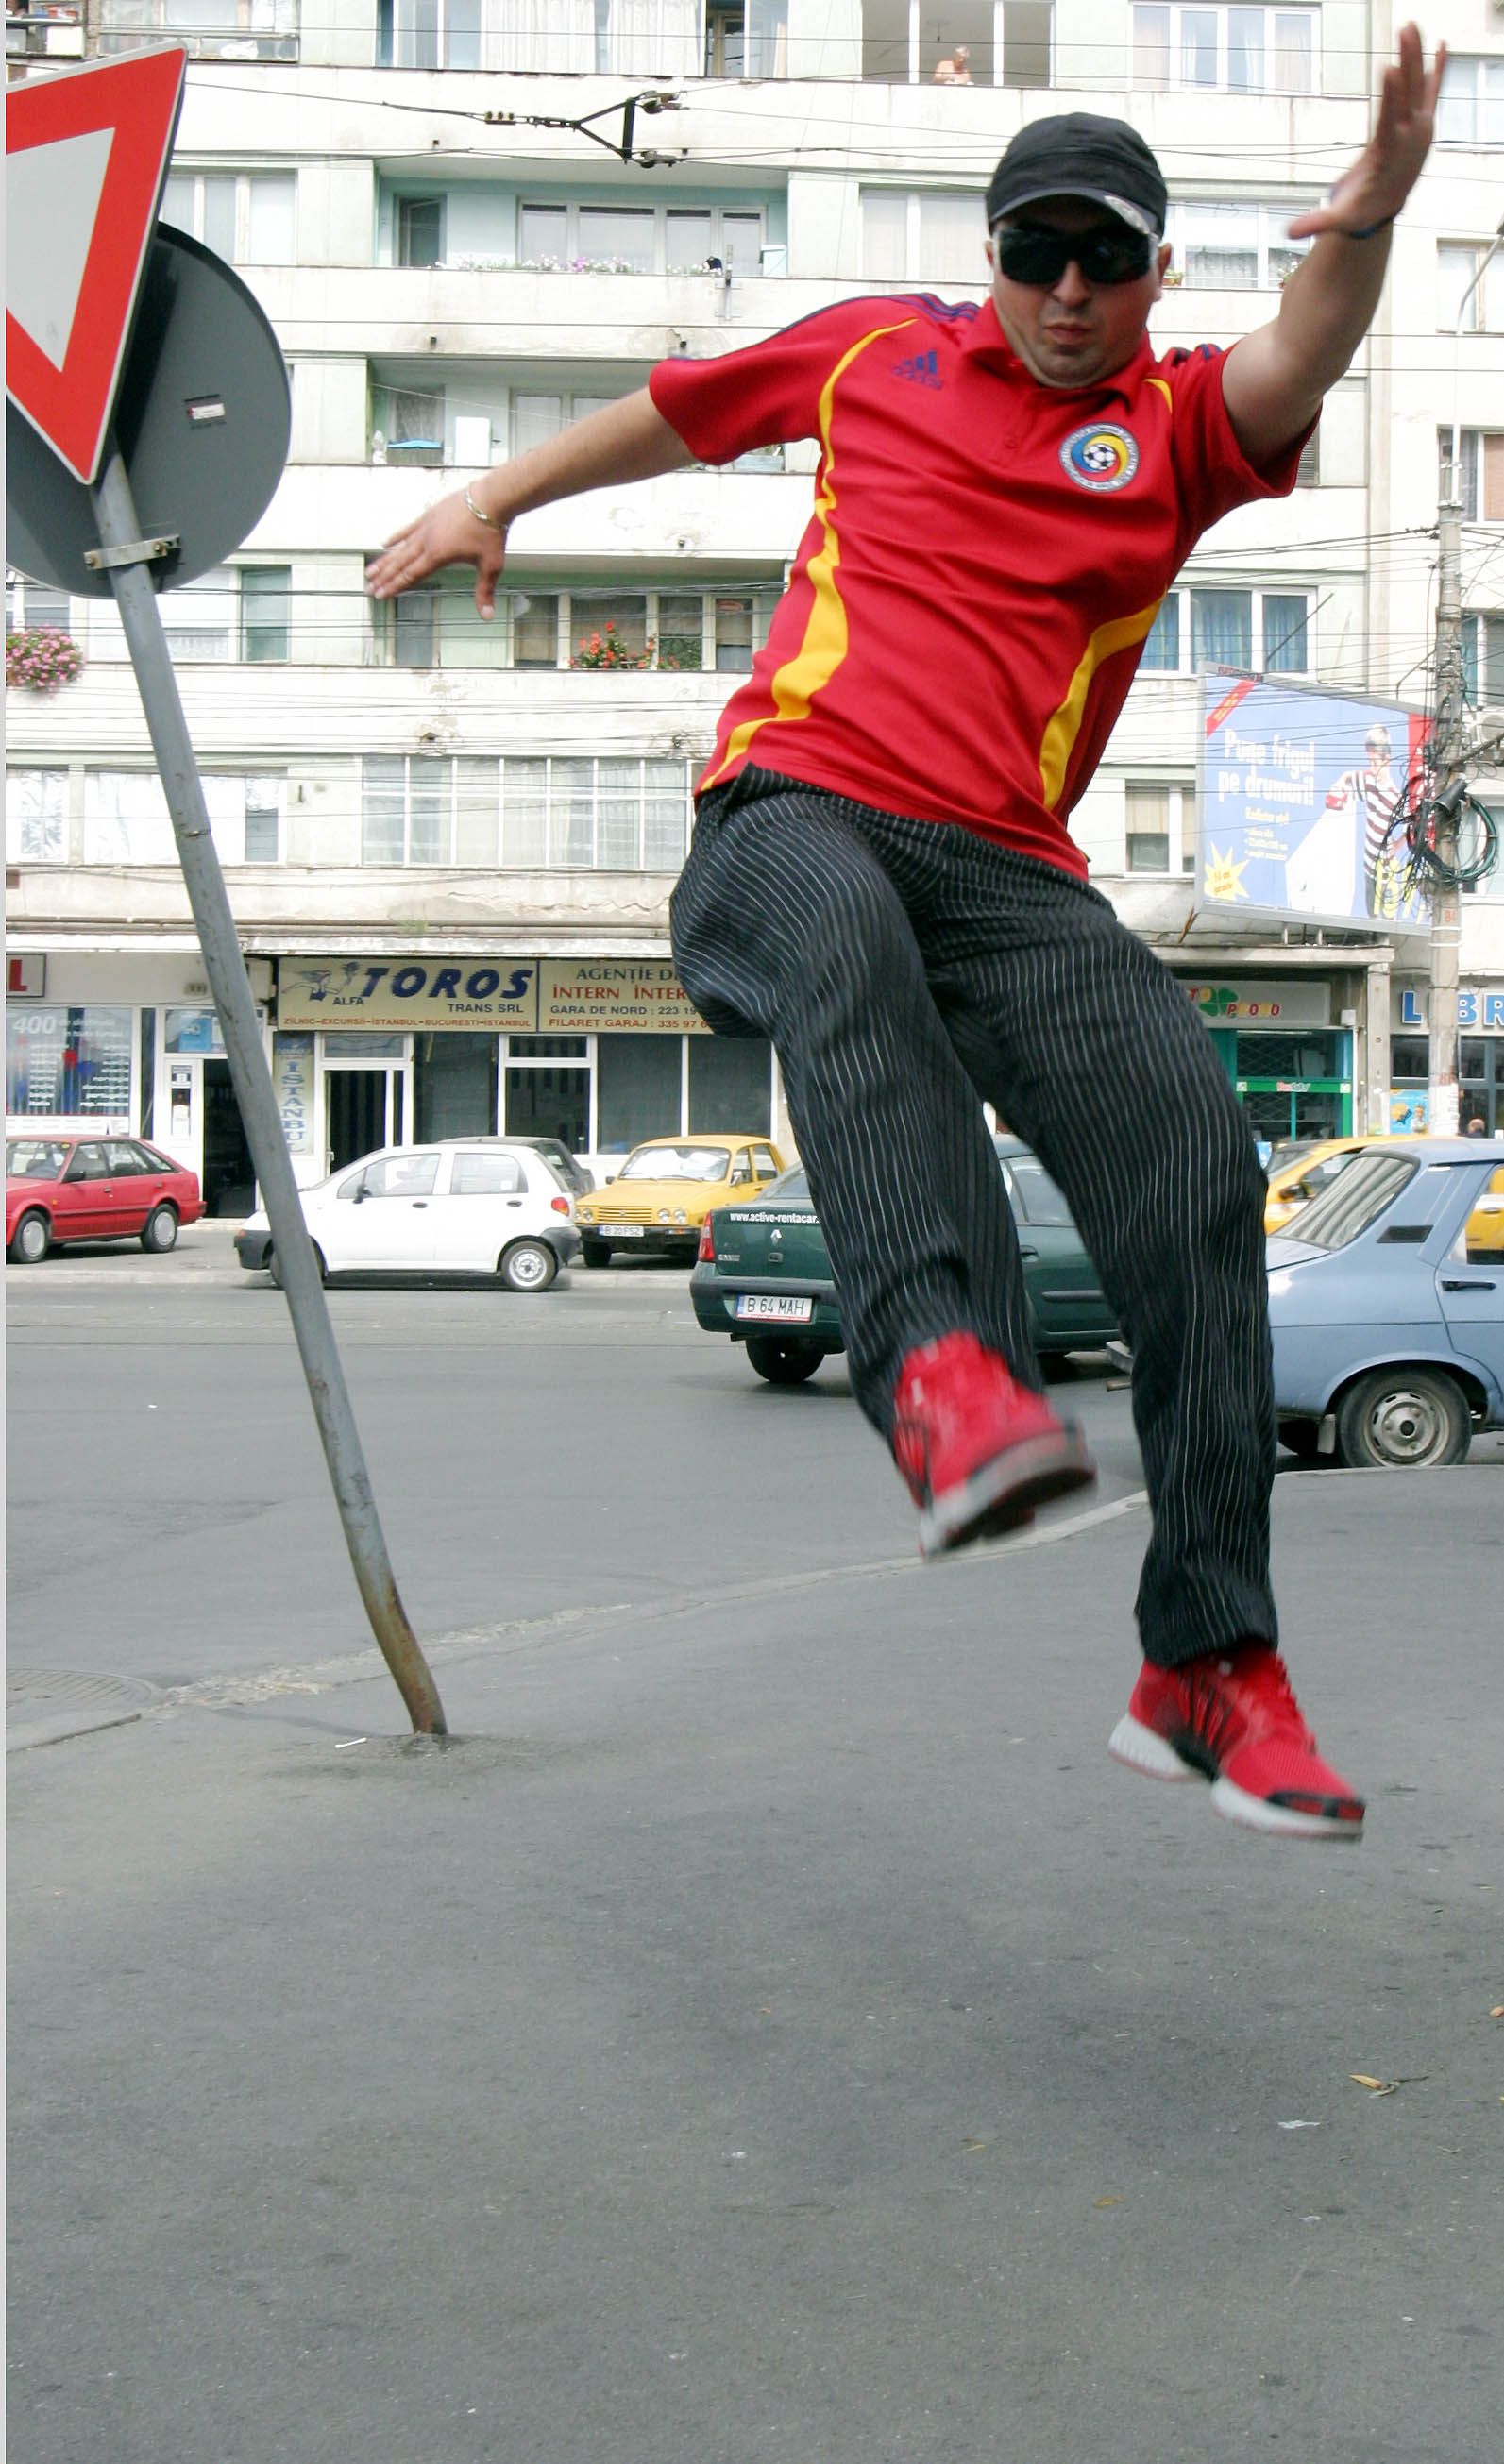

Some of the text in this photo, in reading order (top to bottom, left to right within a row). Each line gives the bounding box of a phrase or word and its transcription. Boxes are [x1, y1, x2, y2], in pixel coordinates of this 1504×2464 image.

[1218, 770, 1240, 802] pe
[9, 959, 28, 991] L
[361, 966, 533, 999] TOROS
[332, 997, 364, 1005] ALFA
[448, 1004, 524, 1013] TRANS SRL
[550, 1005, 585, 1014] GARA
[590, 1005, 605, 1015] DE
[611, 1005, 647, 1015] NORD
[657, 1006, 679, 1015] 223
[13, 1016, 56, 1035] 400
[549, 1019, 600, 1027] FILARET
[605, 1019, 647, 1027] GARAJ
[683, 1020, 697, 1028] 97
[282, 1061, 305, 1153] ISTANBUL
[747, 1297, 804, 1315] B 64 MAH
